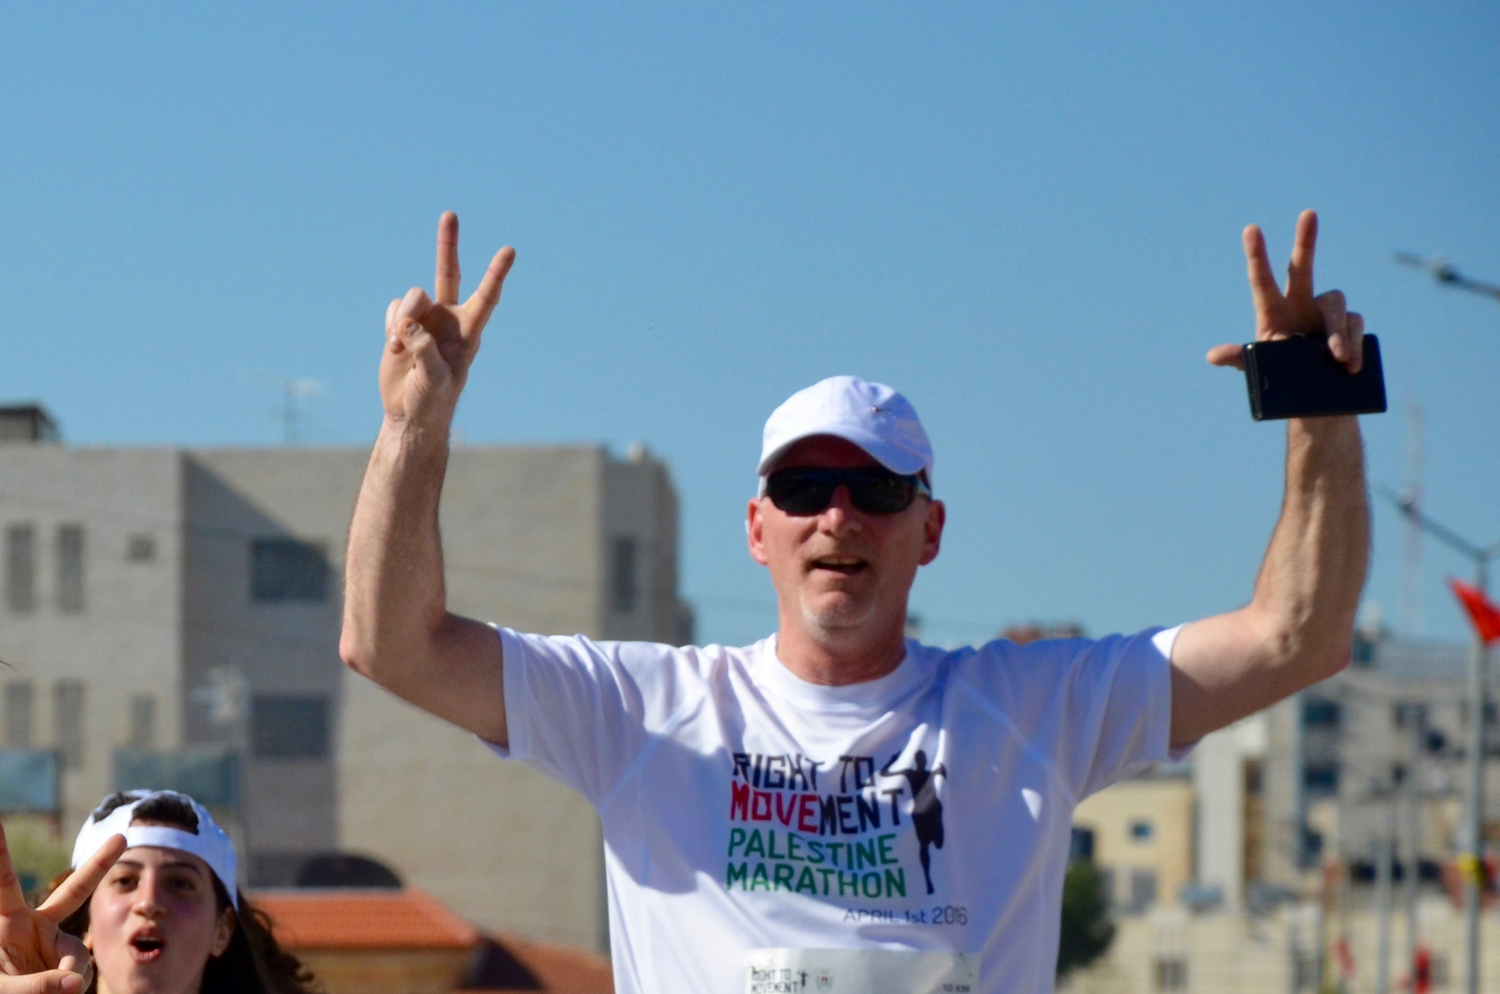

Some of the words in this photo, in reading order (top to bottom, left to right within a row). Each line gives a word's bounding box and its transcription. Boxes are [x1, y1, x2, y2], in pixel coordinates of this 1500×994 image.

[732, 752, 825, 792] RIGHT
[839, 755, 875, 794] TO
[730, 779, 904, 836] MOVEMENT
[728, 827, 899, 870] PALESTINE
[725, 861, 907, 898] MARATHON
[843, 907, 894, 922] APRIL
[905, 909, 927, 924] 1st
[780, 968, 792, 981] TO
